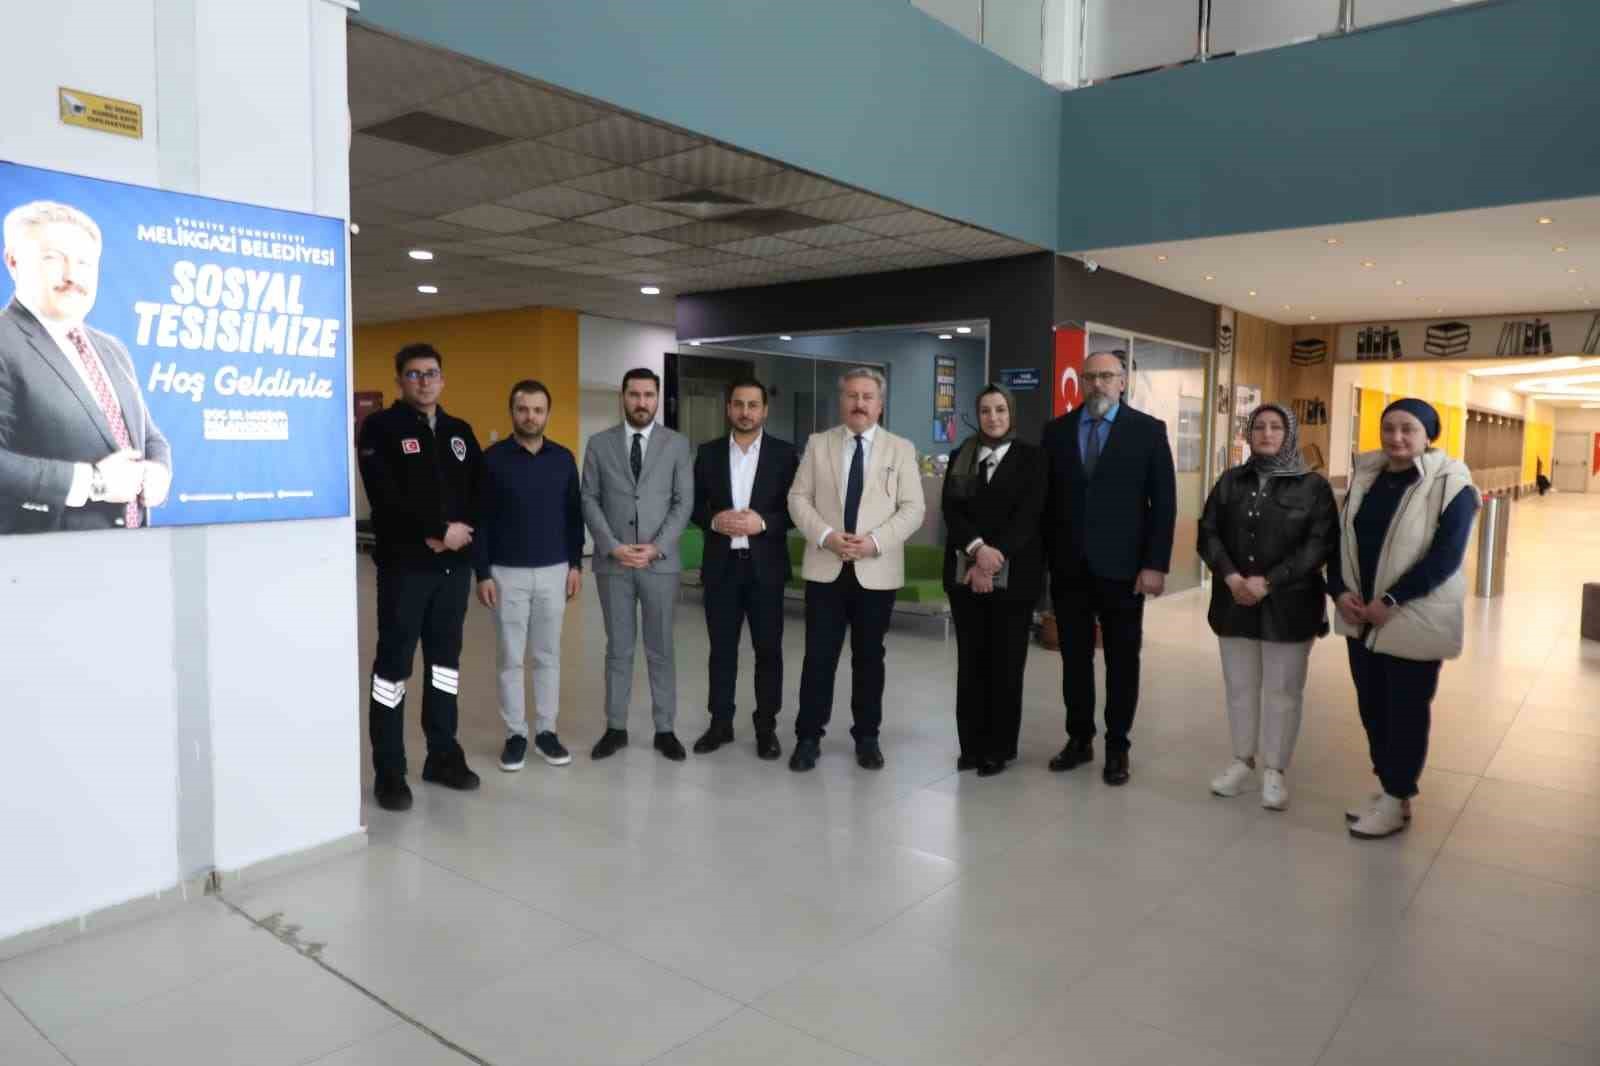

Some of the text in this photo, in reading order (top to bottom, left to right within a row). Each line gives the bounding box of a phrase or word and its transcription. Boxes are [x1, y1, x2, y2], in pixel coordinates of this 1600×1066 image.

[137, 223, 336, 267] MELİKGAZİ BELEDİYESİ
[170, 260, 304, 315] SOSYAL
[147, 361, 334, 402] Hoş Geldiniz
